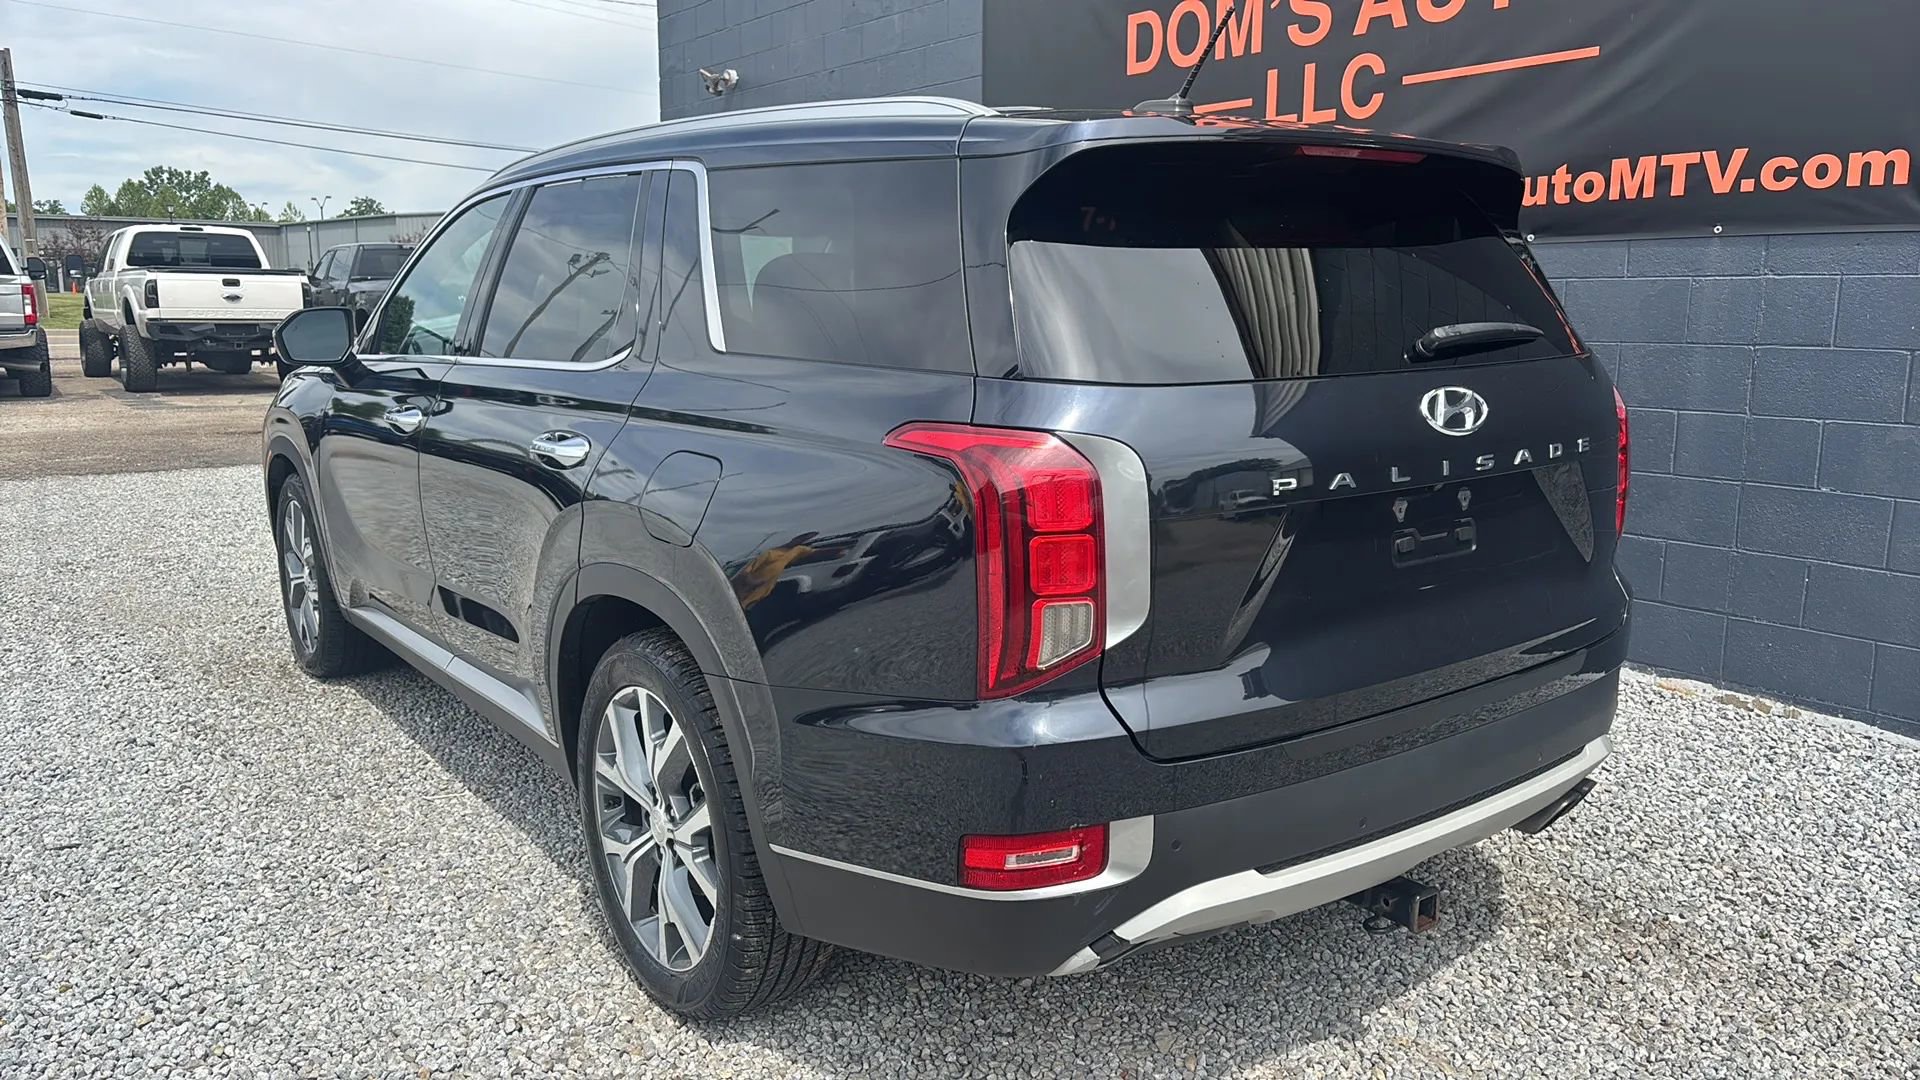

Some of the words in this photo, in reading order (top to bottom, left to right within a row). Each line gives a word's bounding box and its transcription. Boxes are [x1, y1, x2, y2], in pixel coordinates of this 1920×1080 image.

[1265, 53, 1386, 124] LLC
[1521, 147, 1911, 207] utoMTV.com
[1272, 437, 1591, 496] PALISADE
